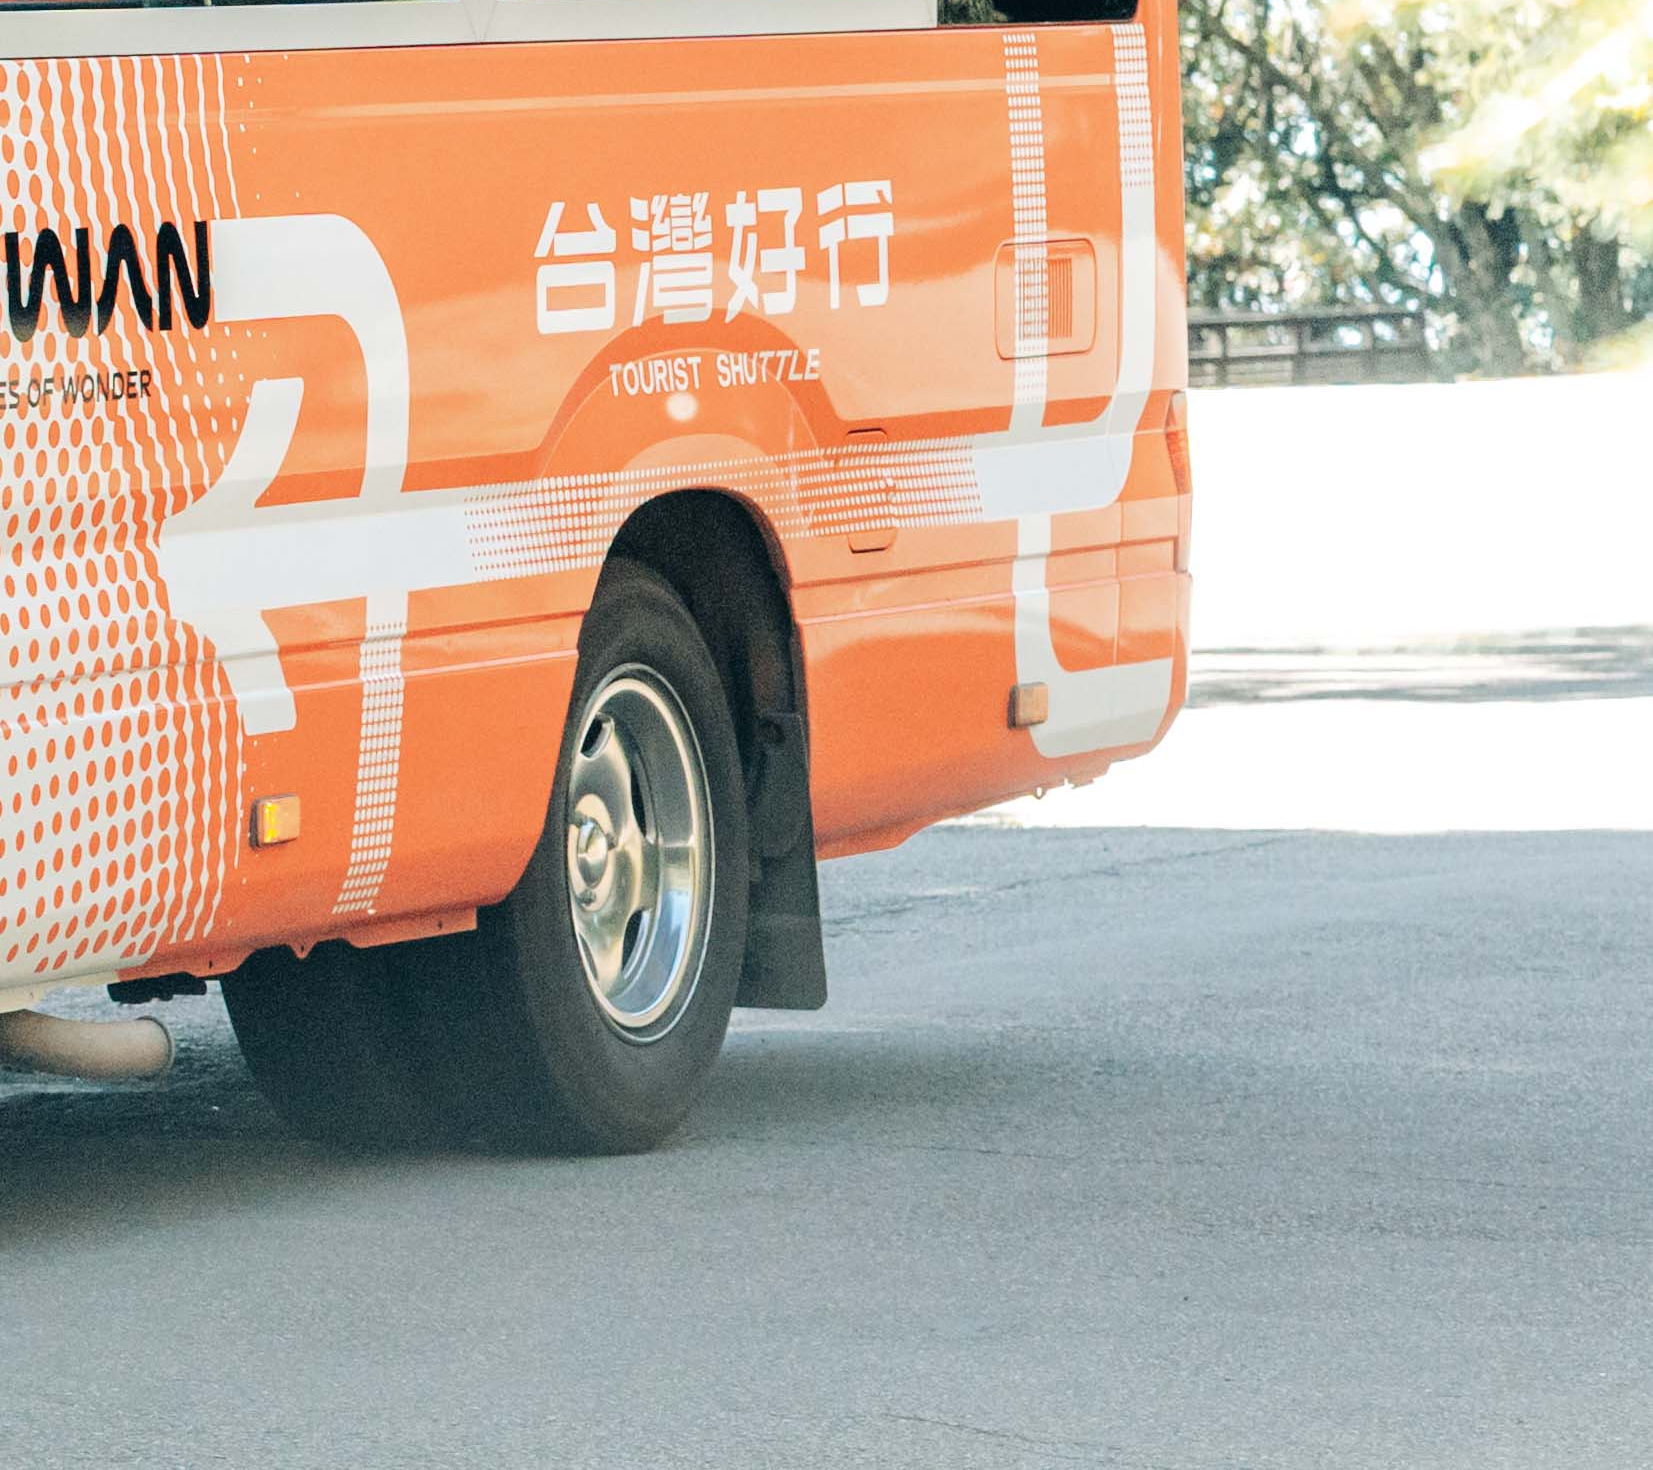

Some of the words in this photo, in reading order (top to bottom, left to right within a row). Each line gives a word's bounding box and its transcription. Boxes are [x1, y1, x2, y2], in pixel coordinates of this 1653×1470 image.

[533, 179, 896, 336] 台灣好行
[27, 377, 55, 407] OF
[60, 369, 152, 403] WONDER
[609, 355, 702, 398] TOURIST
[716, 347, 822, 388] SHUTTLE
